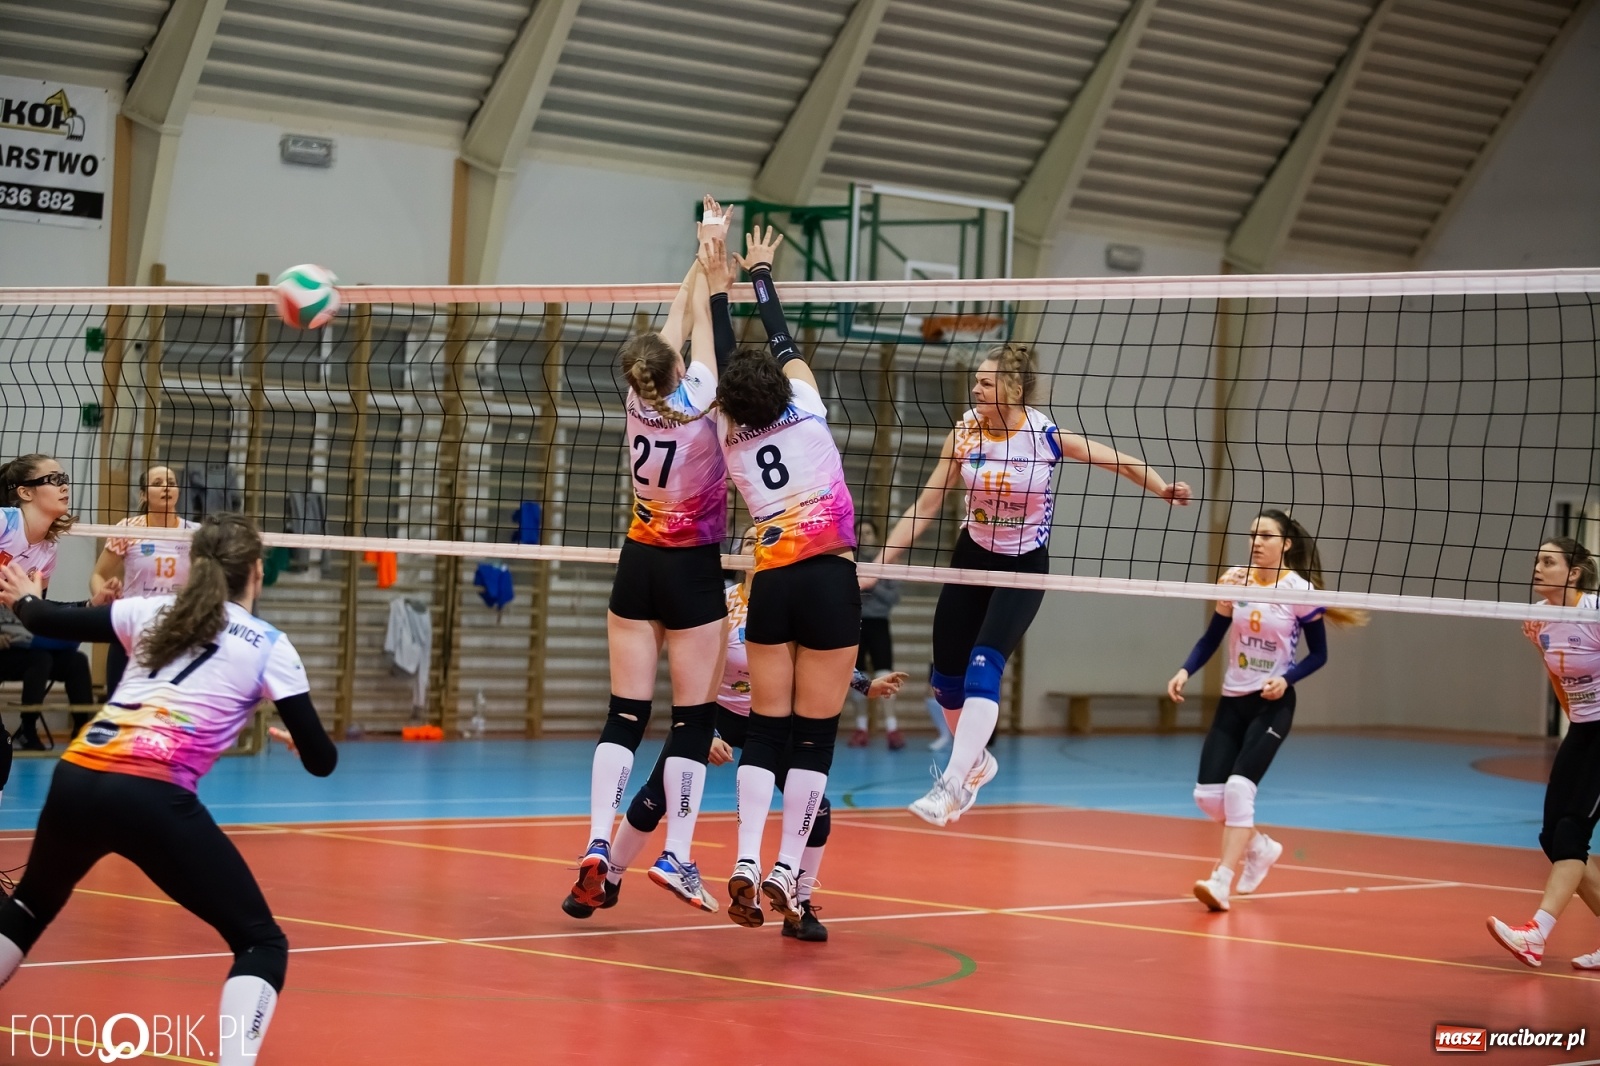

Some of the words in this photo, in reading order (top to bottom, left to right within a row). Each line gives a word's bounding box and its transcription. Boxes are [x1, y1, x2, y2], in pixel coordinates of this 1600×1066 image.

[0, 144, 99, 177] RSTWO
[37, 190, 75, 212] 882
[633, 434, 677, 489] 27
[756, 444, 790, 491] 8
[982, 470, 1012, 497] 15
[155, 557, 177, 579] 13
[1250, 610, 1261, 633] 8
